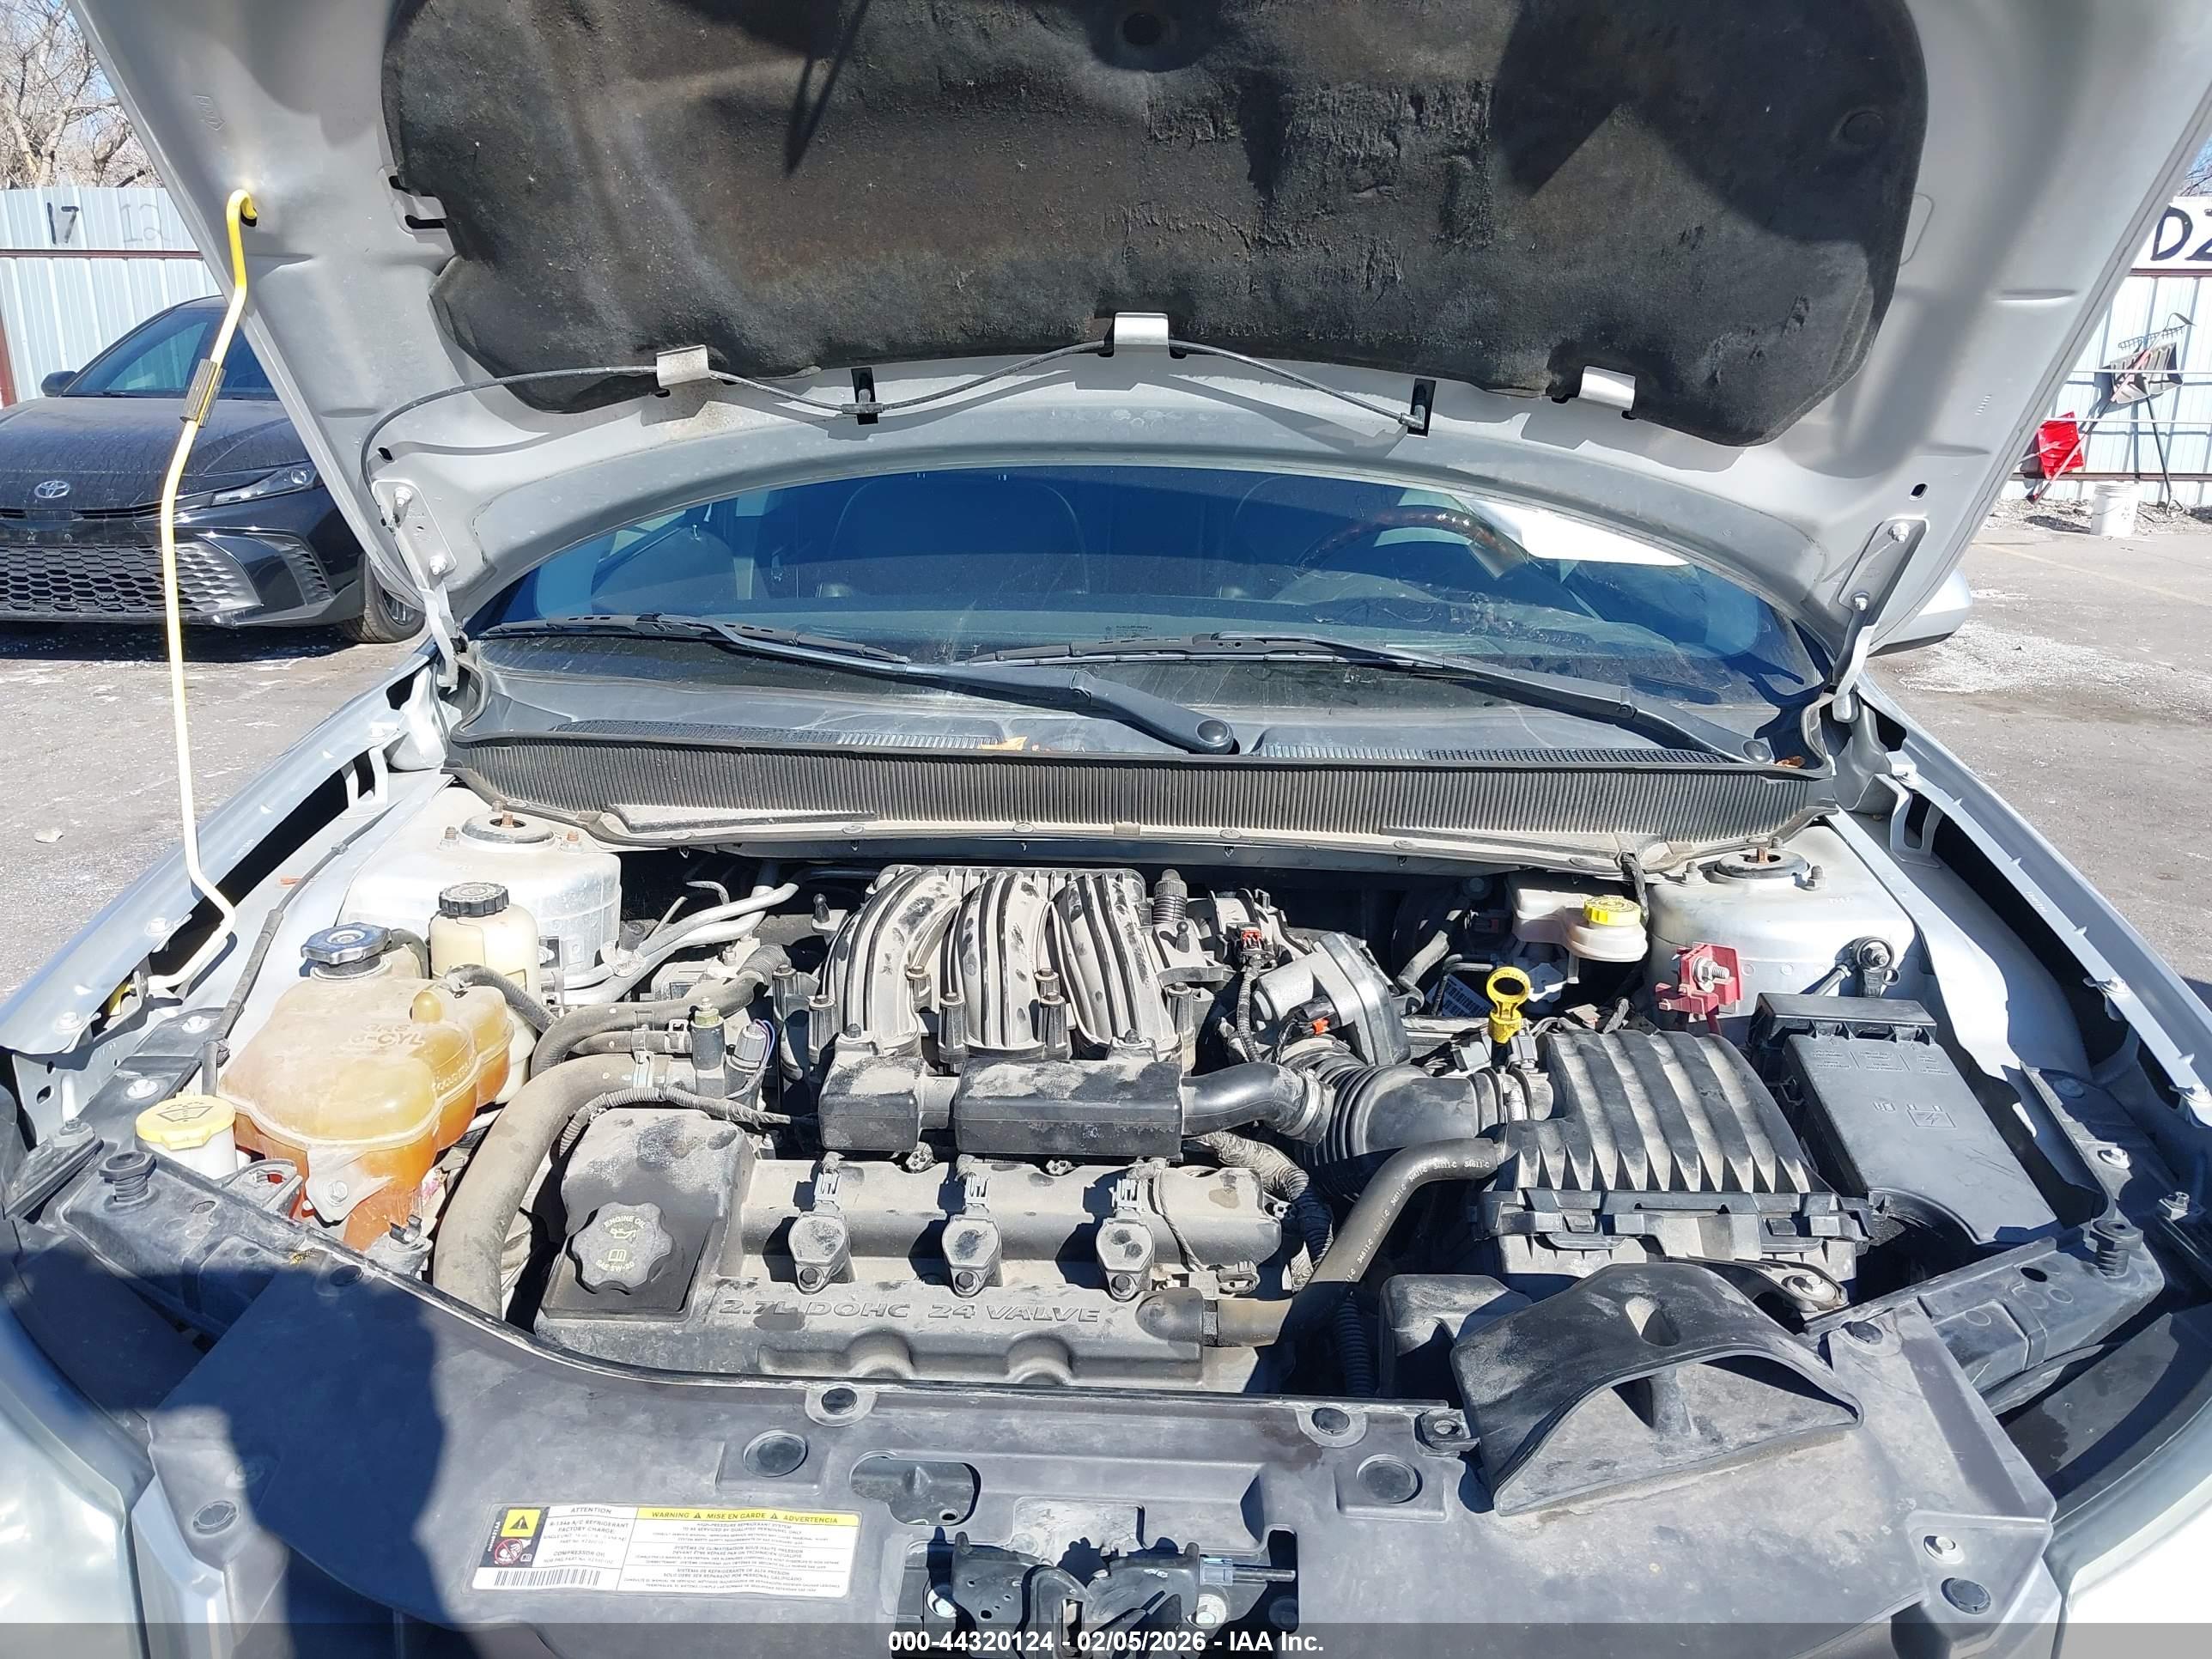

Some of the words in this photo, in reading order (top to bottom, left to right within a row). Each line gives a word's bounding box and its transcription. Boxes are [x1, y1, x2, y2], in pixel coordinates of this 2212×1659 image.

[603, 1215, 635, 1228] ENGINE
[634, 1217, 647, 1229] OIL
[805, 1302, 911, 1319] DOHC
[927, 1304, 976, 1320] 24
[986, 1304, 1101, 1323] VALVE
[570, 1506, 612, 1515] ATTENTION
[585, 1519, 629, 1528] REFRIGERANT
[783, 1515, 837, 1523] ADVERTENCIA
[552, 1549, 595, 1558] COMPRESSOR
